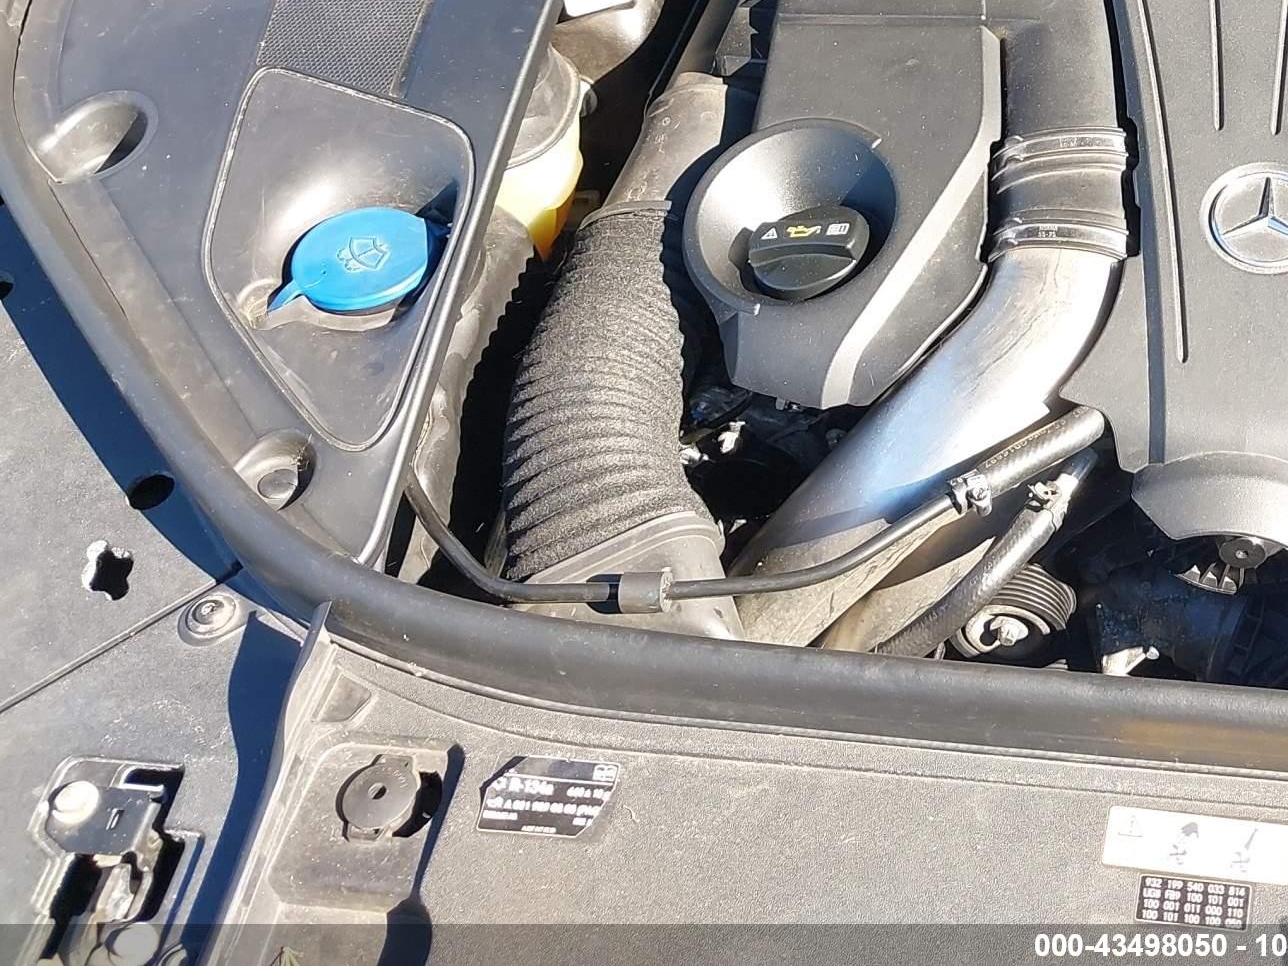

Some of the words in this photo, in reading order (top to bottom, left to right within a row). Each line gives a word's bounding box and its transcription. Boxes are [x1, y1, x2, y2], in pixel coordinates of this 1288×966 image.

[1186, 881, 1204, 892] 540
[1207, 883, 1225, 895] 033
[1228, 885, 1246, 896] 814
[1143, 898, 1160, 909] 100
[1163, 900, 1180, 911] 001
[1183, 902, 1201, 913] 011
[1204, 905, 1223, 915] 000
[1227, 907, 1244, 919] 110
[1186, 892, 1203, 903] 100
[1207, 894, 1223, 906] 101
[1227, 896, 1244, 908] 001
[1142, 909, 1158, 920] 100
[1163, 911, 1179, 922] 101
[1183, 913, 1200, 924] 100
[1205, 916, 1221, 927] 100
